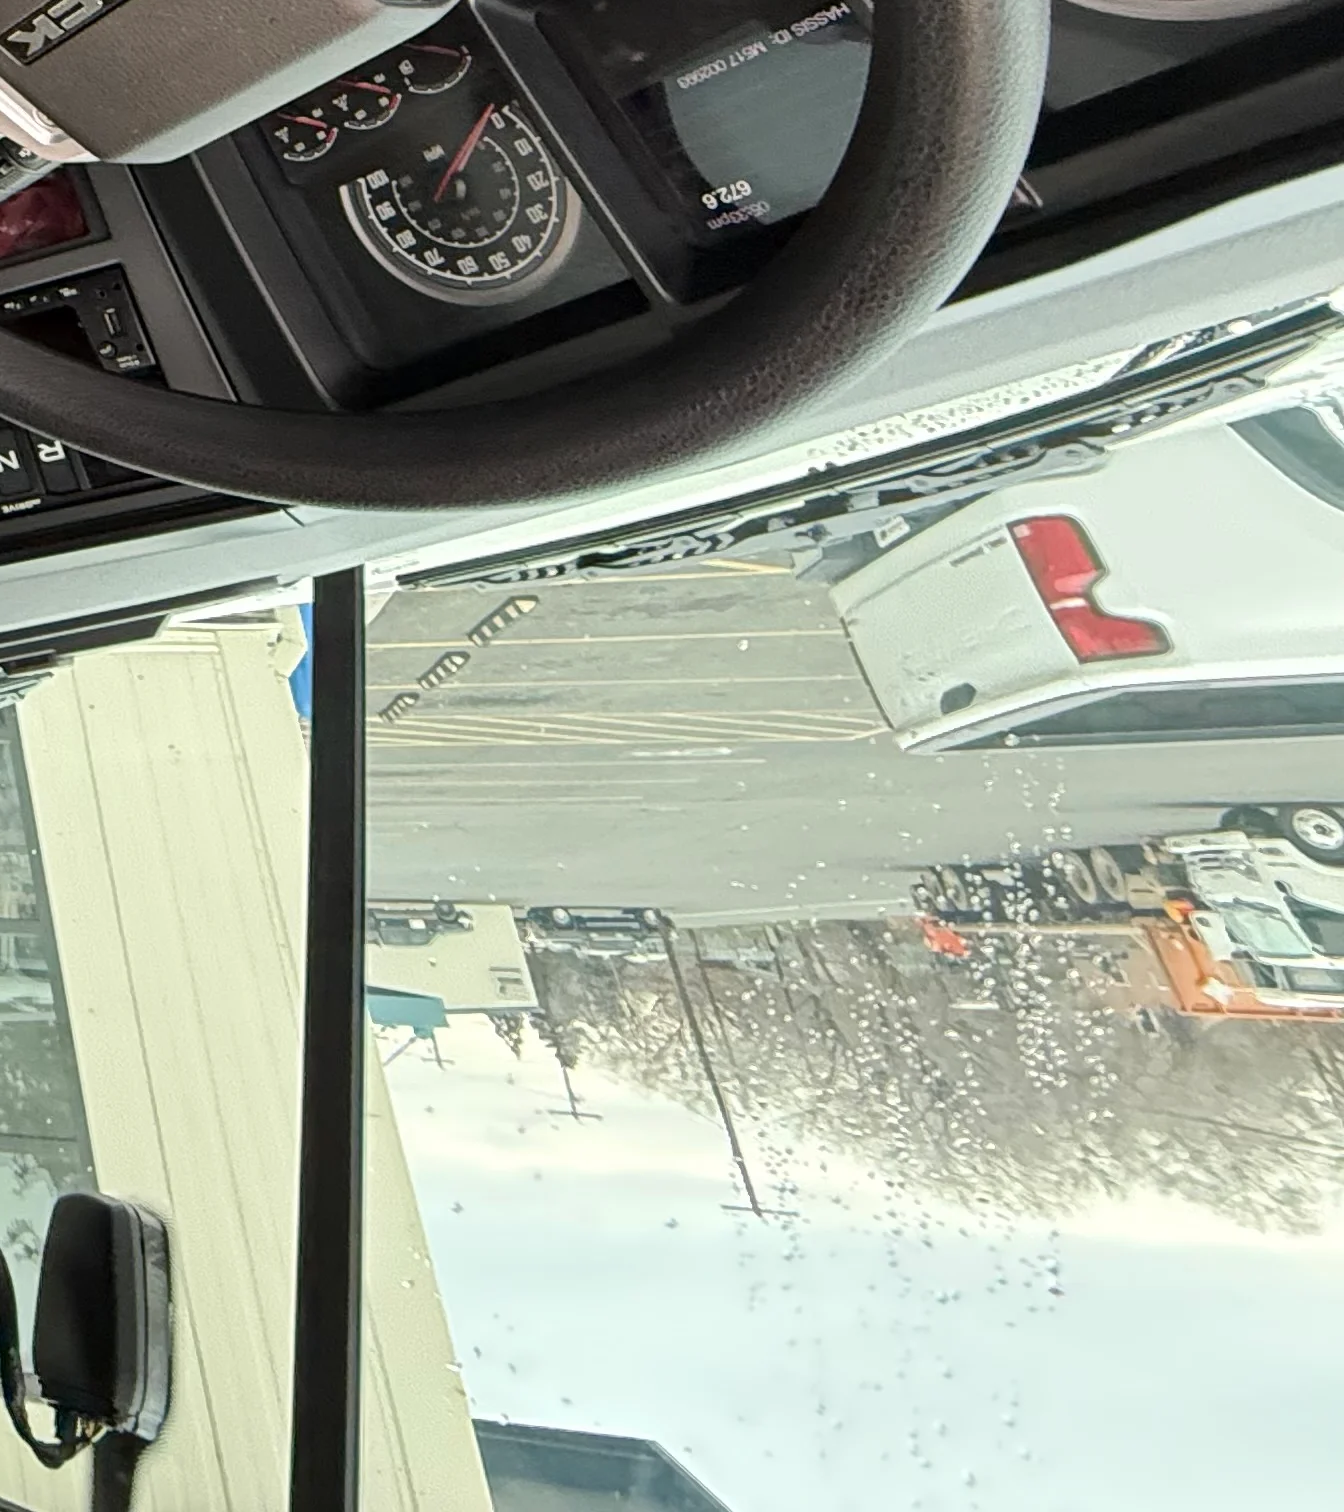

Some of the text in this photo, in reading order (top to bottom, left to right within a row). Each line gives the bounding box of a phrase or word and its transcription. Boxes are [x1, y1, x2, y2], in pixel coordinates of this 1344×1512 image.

[790, 2, 851, 37] HASSIS
[490, 112, 506, 130] 0
[514, 137, 533, 156] 10
[366, 168, 390, 189] 100
[526, 170, 550, 191] 20
[702, 180, 752, 210] 672.6
[375, 201, 396, 221] 90
[525, 203, 549, 224] 30
[395, 229, 417, 249] 80
[511, 234, 532, 253] 40
[423, 247, 445, 266] 70
[457, 255, 479, 275] 60
[488, 251, 511, 271] 50
[37, 440, 66, 463] R
